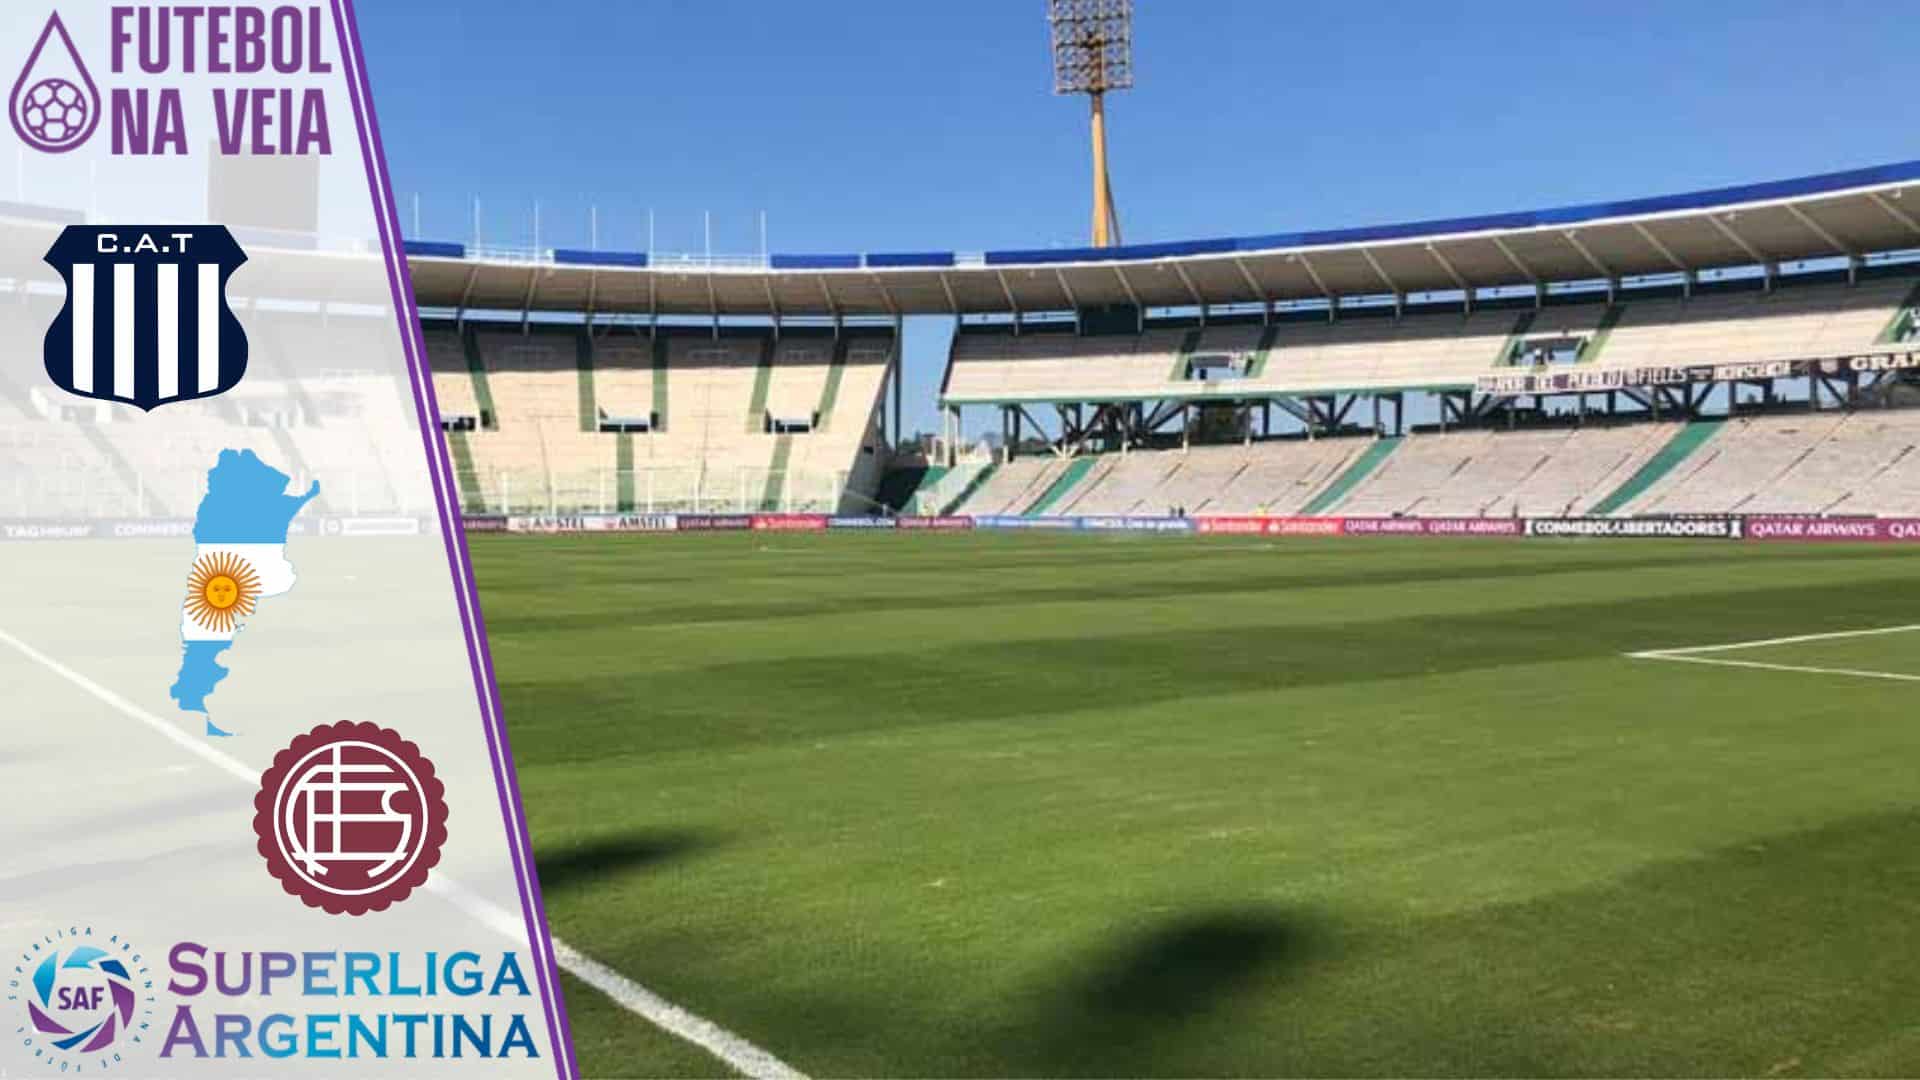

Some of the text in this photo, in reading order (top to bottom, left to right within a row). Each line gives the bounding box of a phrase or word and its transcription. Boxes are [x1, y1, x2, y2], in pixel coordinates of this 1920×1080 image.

[618, 516, 667, 529] AMSTEL
[1750, 522, 1876, 538] QATAR AIRWAYS
